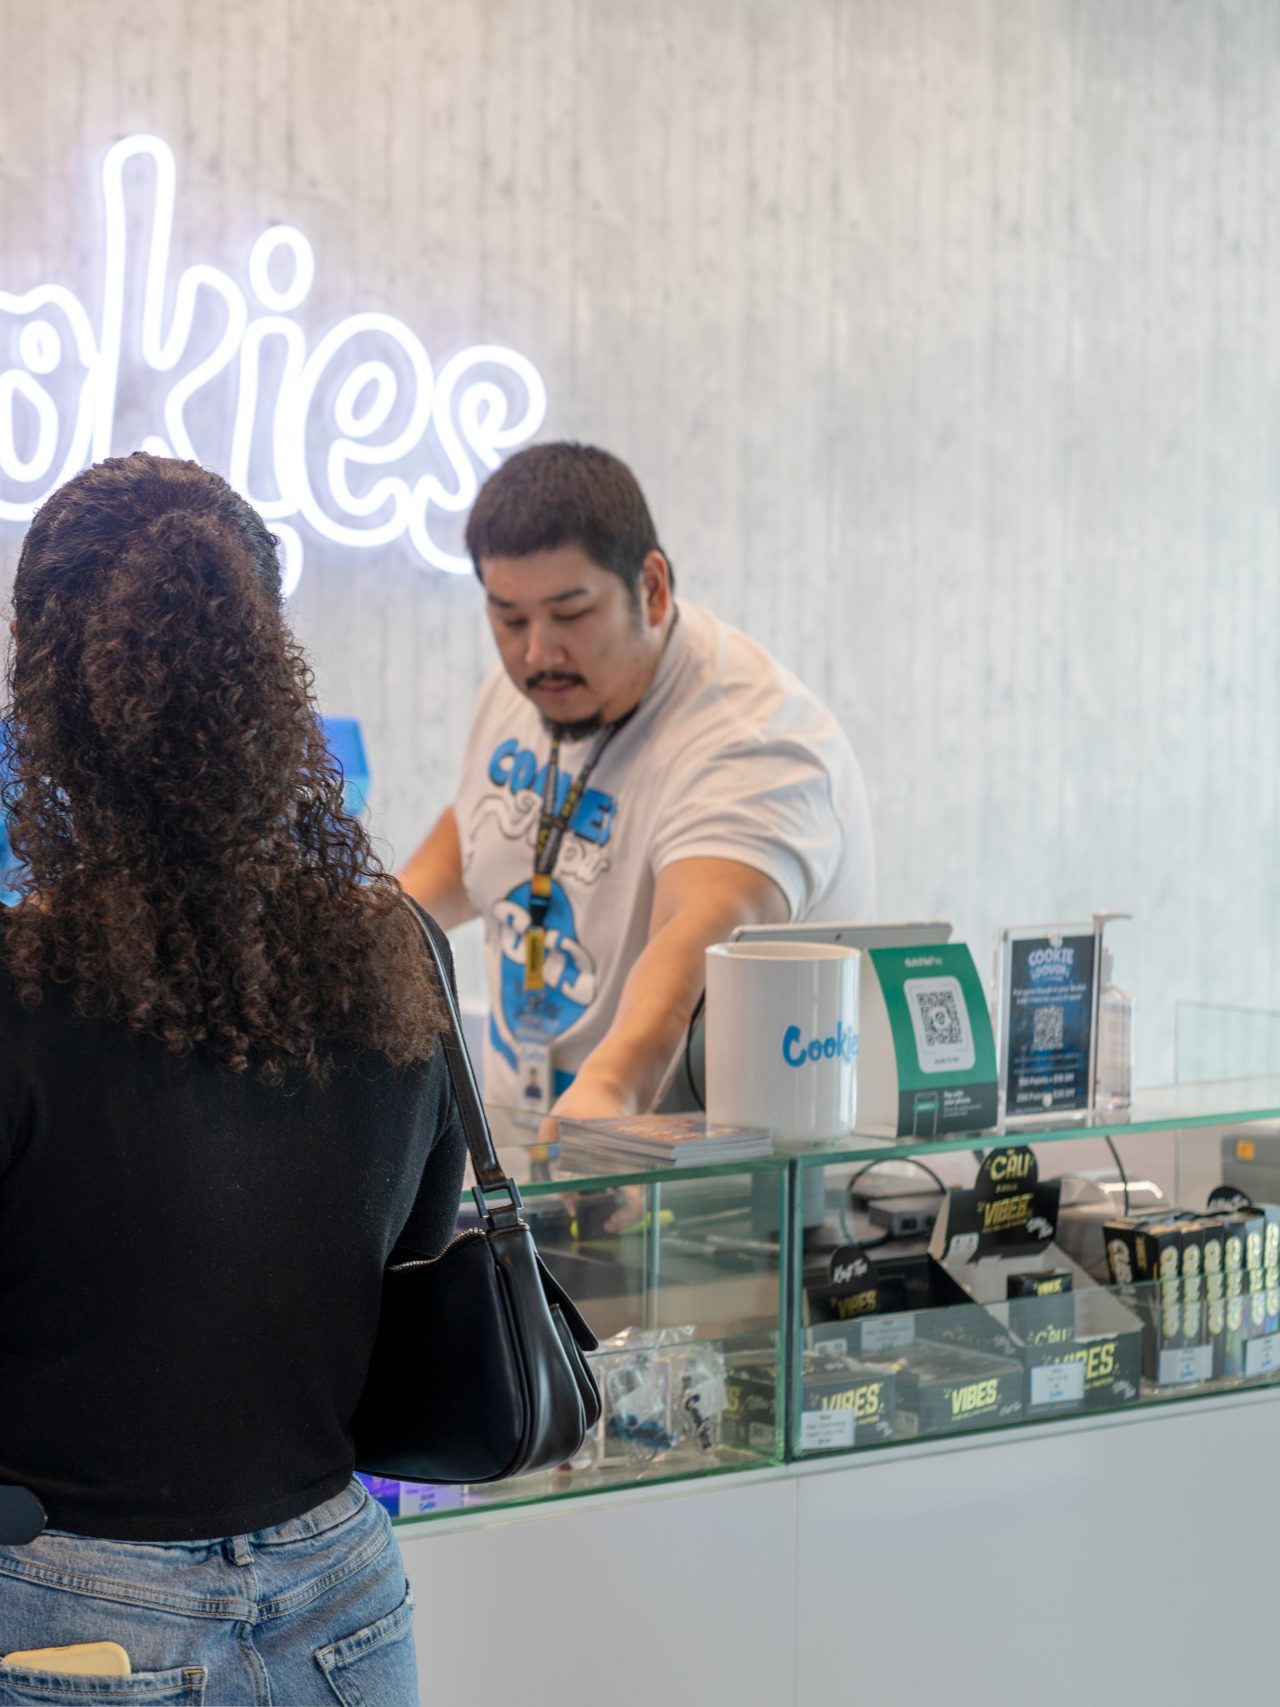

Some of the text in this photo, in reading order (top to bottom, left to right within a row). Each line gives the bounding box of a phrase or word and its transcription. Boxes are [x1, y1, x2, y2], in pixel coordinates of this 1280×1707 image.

[1028, 948, 1074, 966] COOKIE
[991, 1152, 1031, 1180] CALI
[952, 1378, 998, 1414] VIBES
